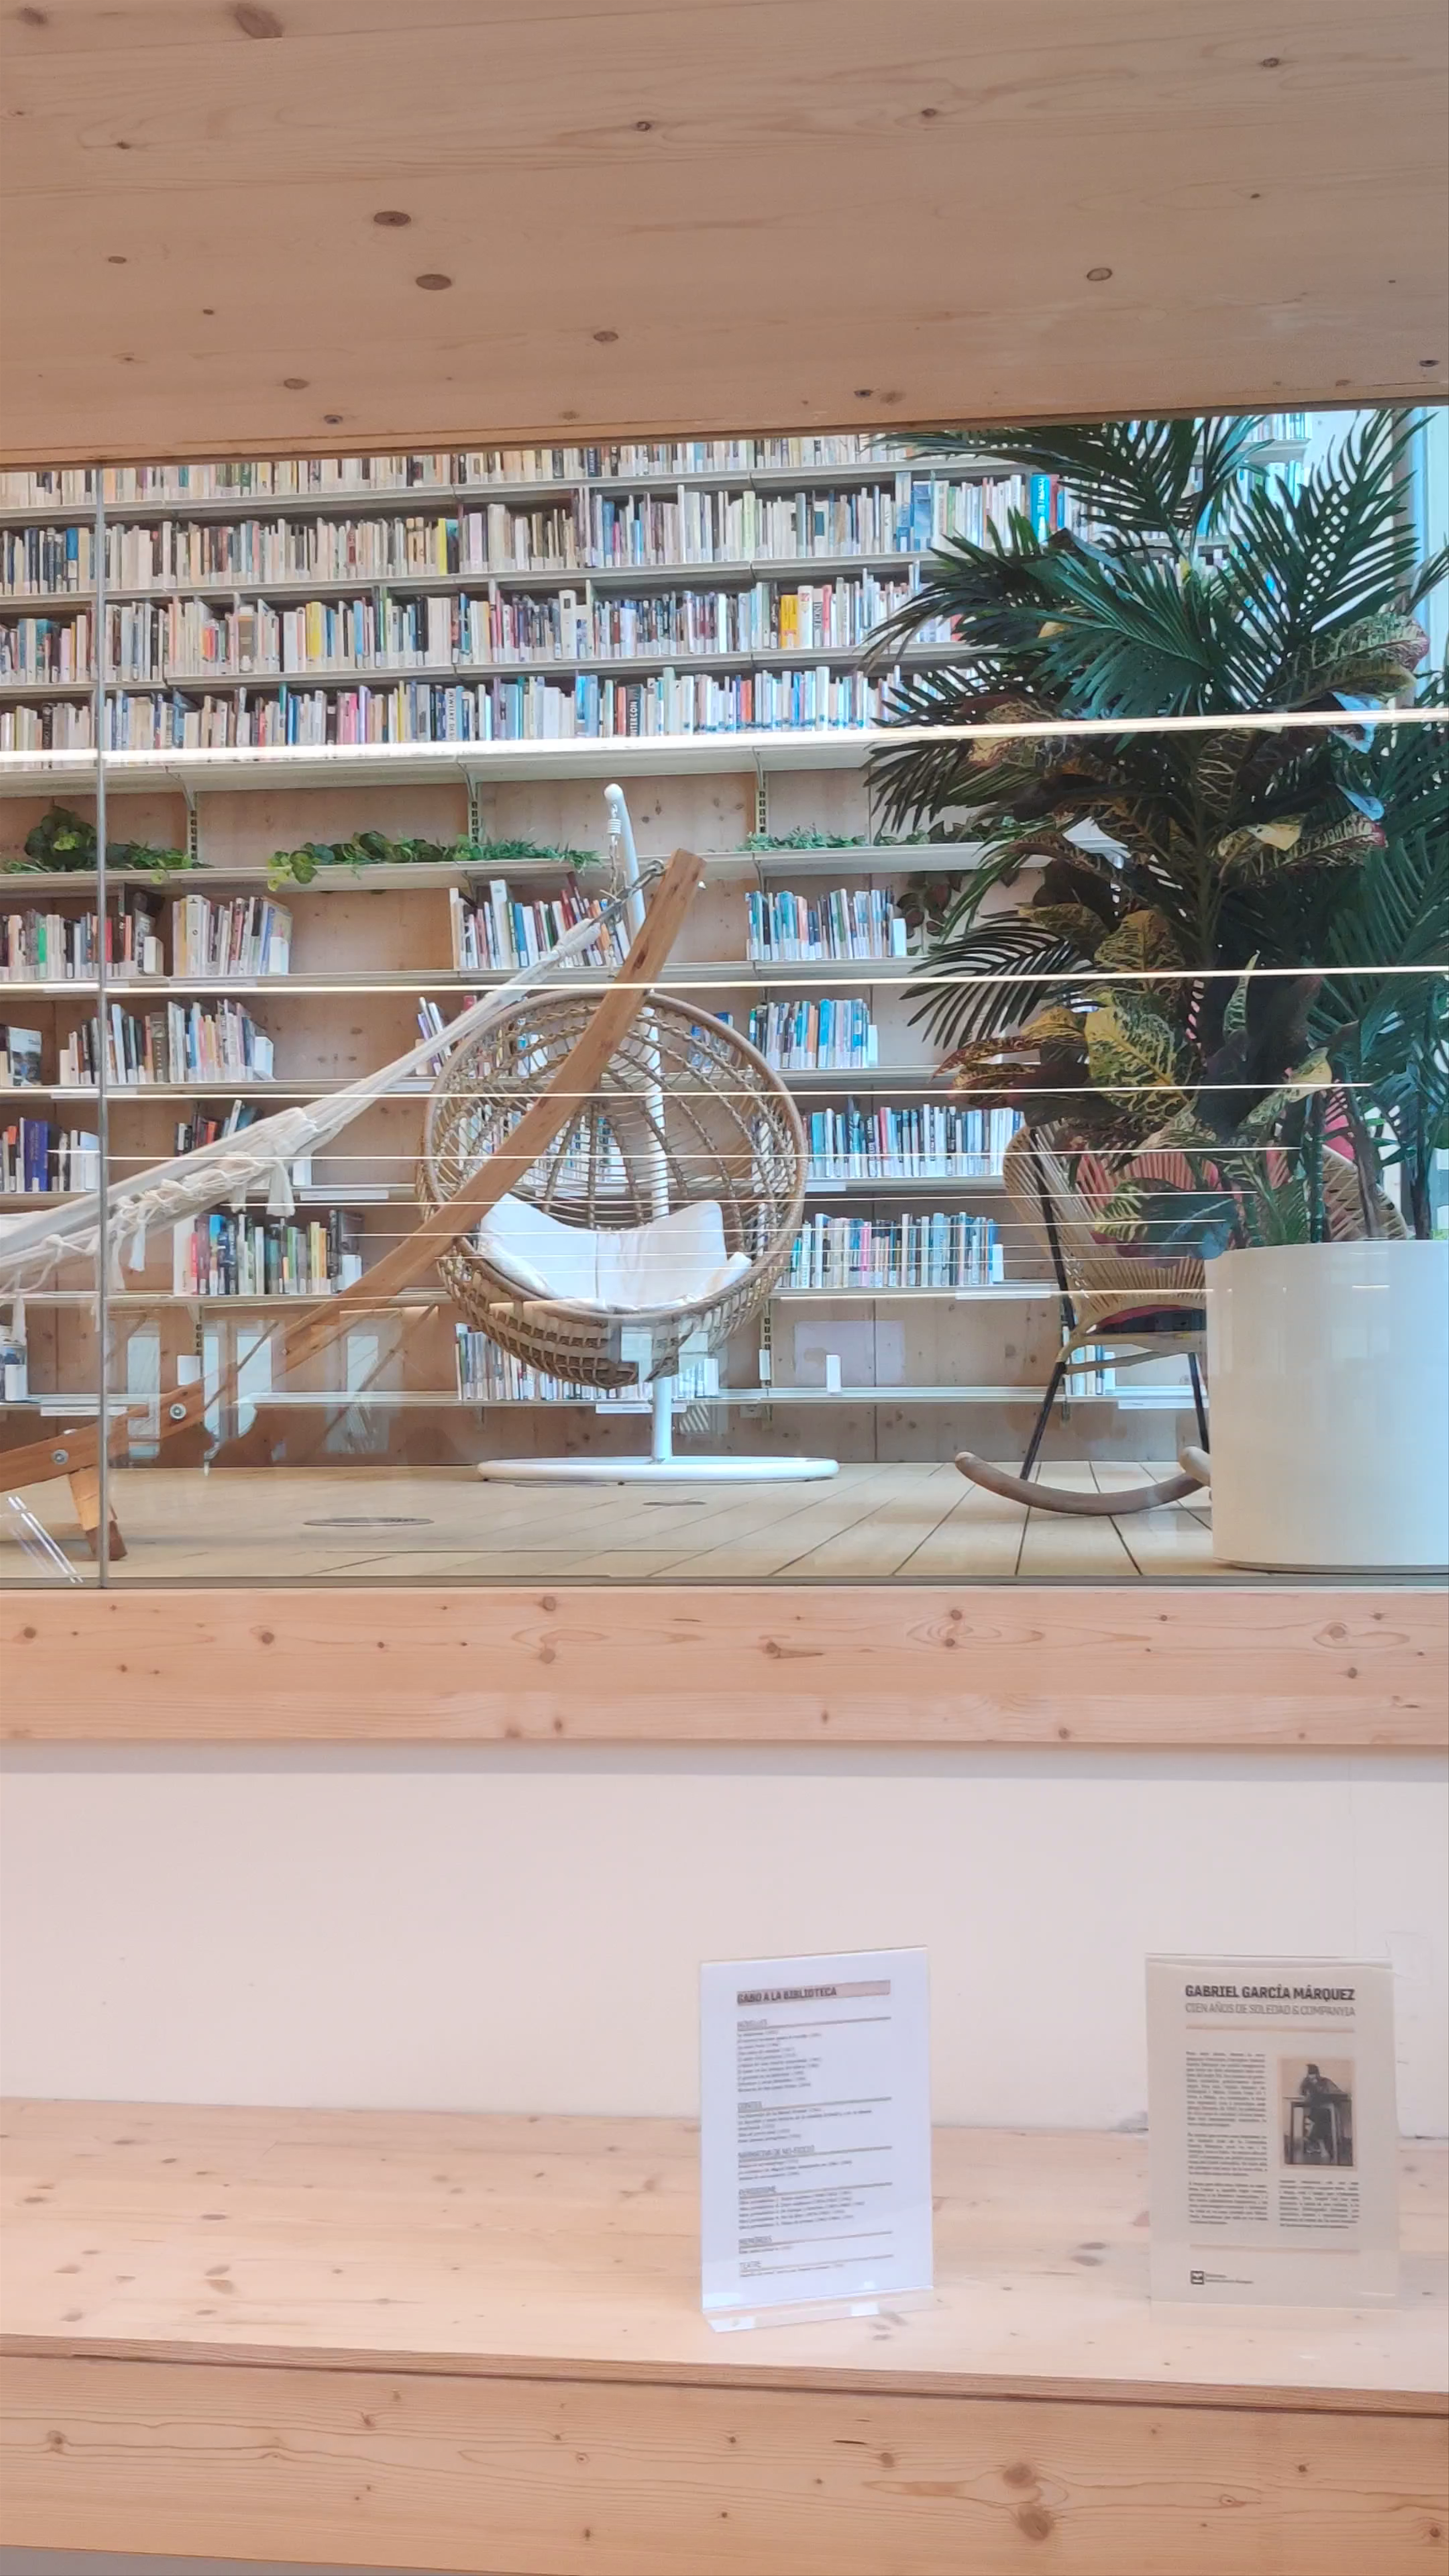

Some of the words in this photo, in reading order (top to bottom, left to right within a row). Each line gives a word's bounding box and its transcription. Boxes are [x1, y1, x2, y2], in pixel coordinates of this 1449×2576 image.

[763, 1993, 770, 2001] A
[771, 1991, 781, 2001] LA
[783, 1987, 837, 1999] BIBLIOTECA
[1185, 1985, 1240, 1998] GABRIEL
[1242, 1984, 1291, 1999] GARCÍA
[1293, 1984, 1356, 2001] MÁRQUEZ
[1185, 2002, 1208, 2013] CIEN
[1209, 2001, 1234, 2013] AÑOS
[1235, 2003, 1247, 2014] DE
[1249, 2004, 1291, 2015] SOLEDAD
[1292, 2005, 1299, 2015] &
[1300, 2005, 1356, 2016] COMPANYIA
